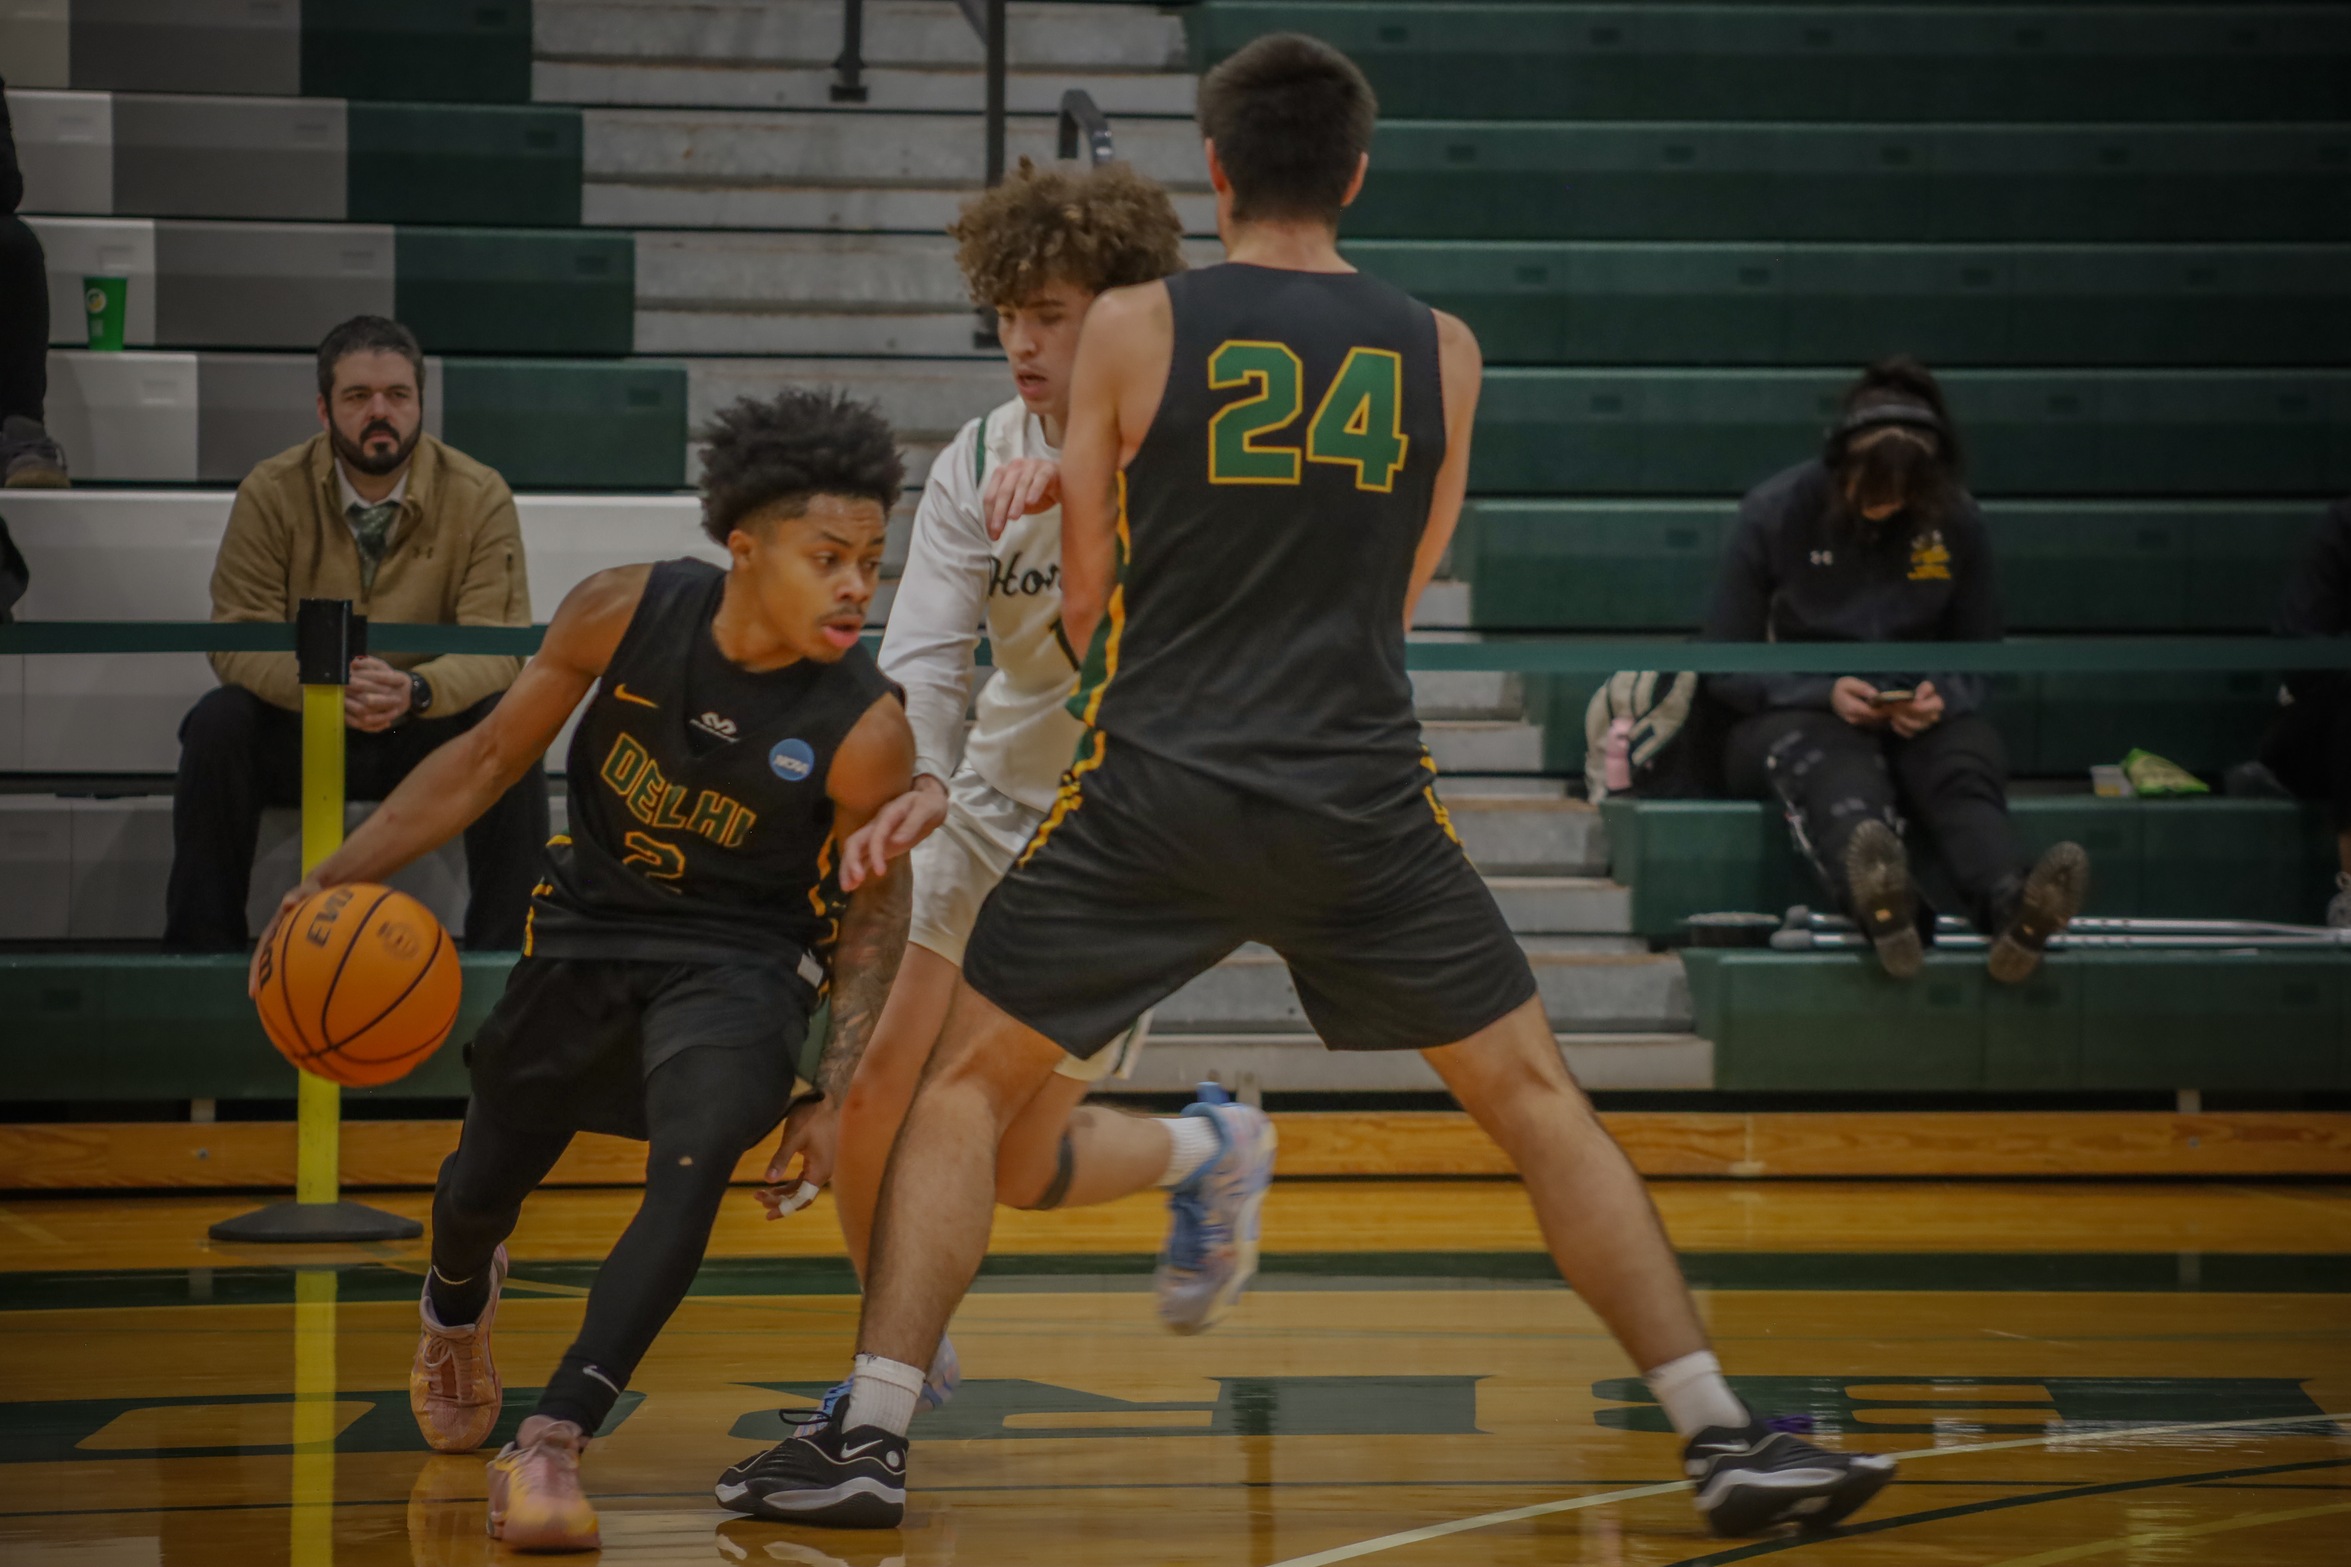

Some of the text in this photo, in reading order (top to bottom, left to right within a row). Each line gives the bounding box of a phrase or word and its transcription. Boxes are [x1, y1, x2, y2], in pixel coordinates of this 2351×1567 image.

[1207, 339, 1409, 493] 24
[600, 731, 757, 847] DELHI
[622, 831, 686, 895] 2
